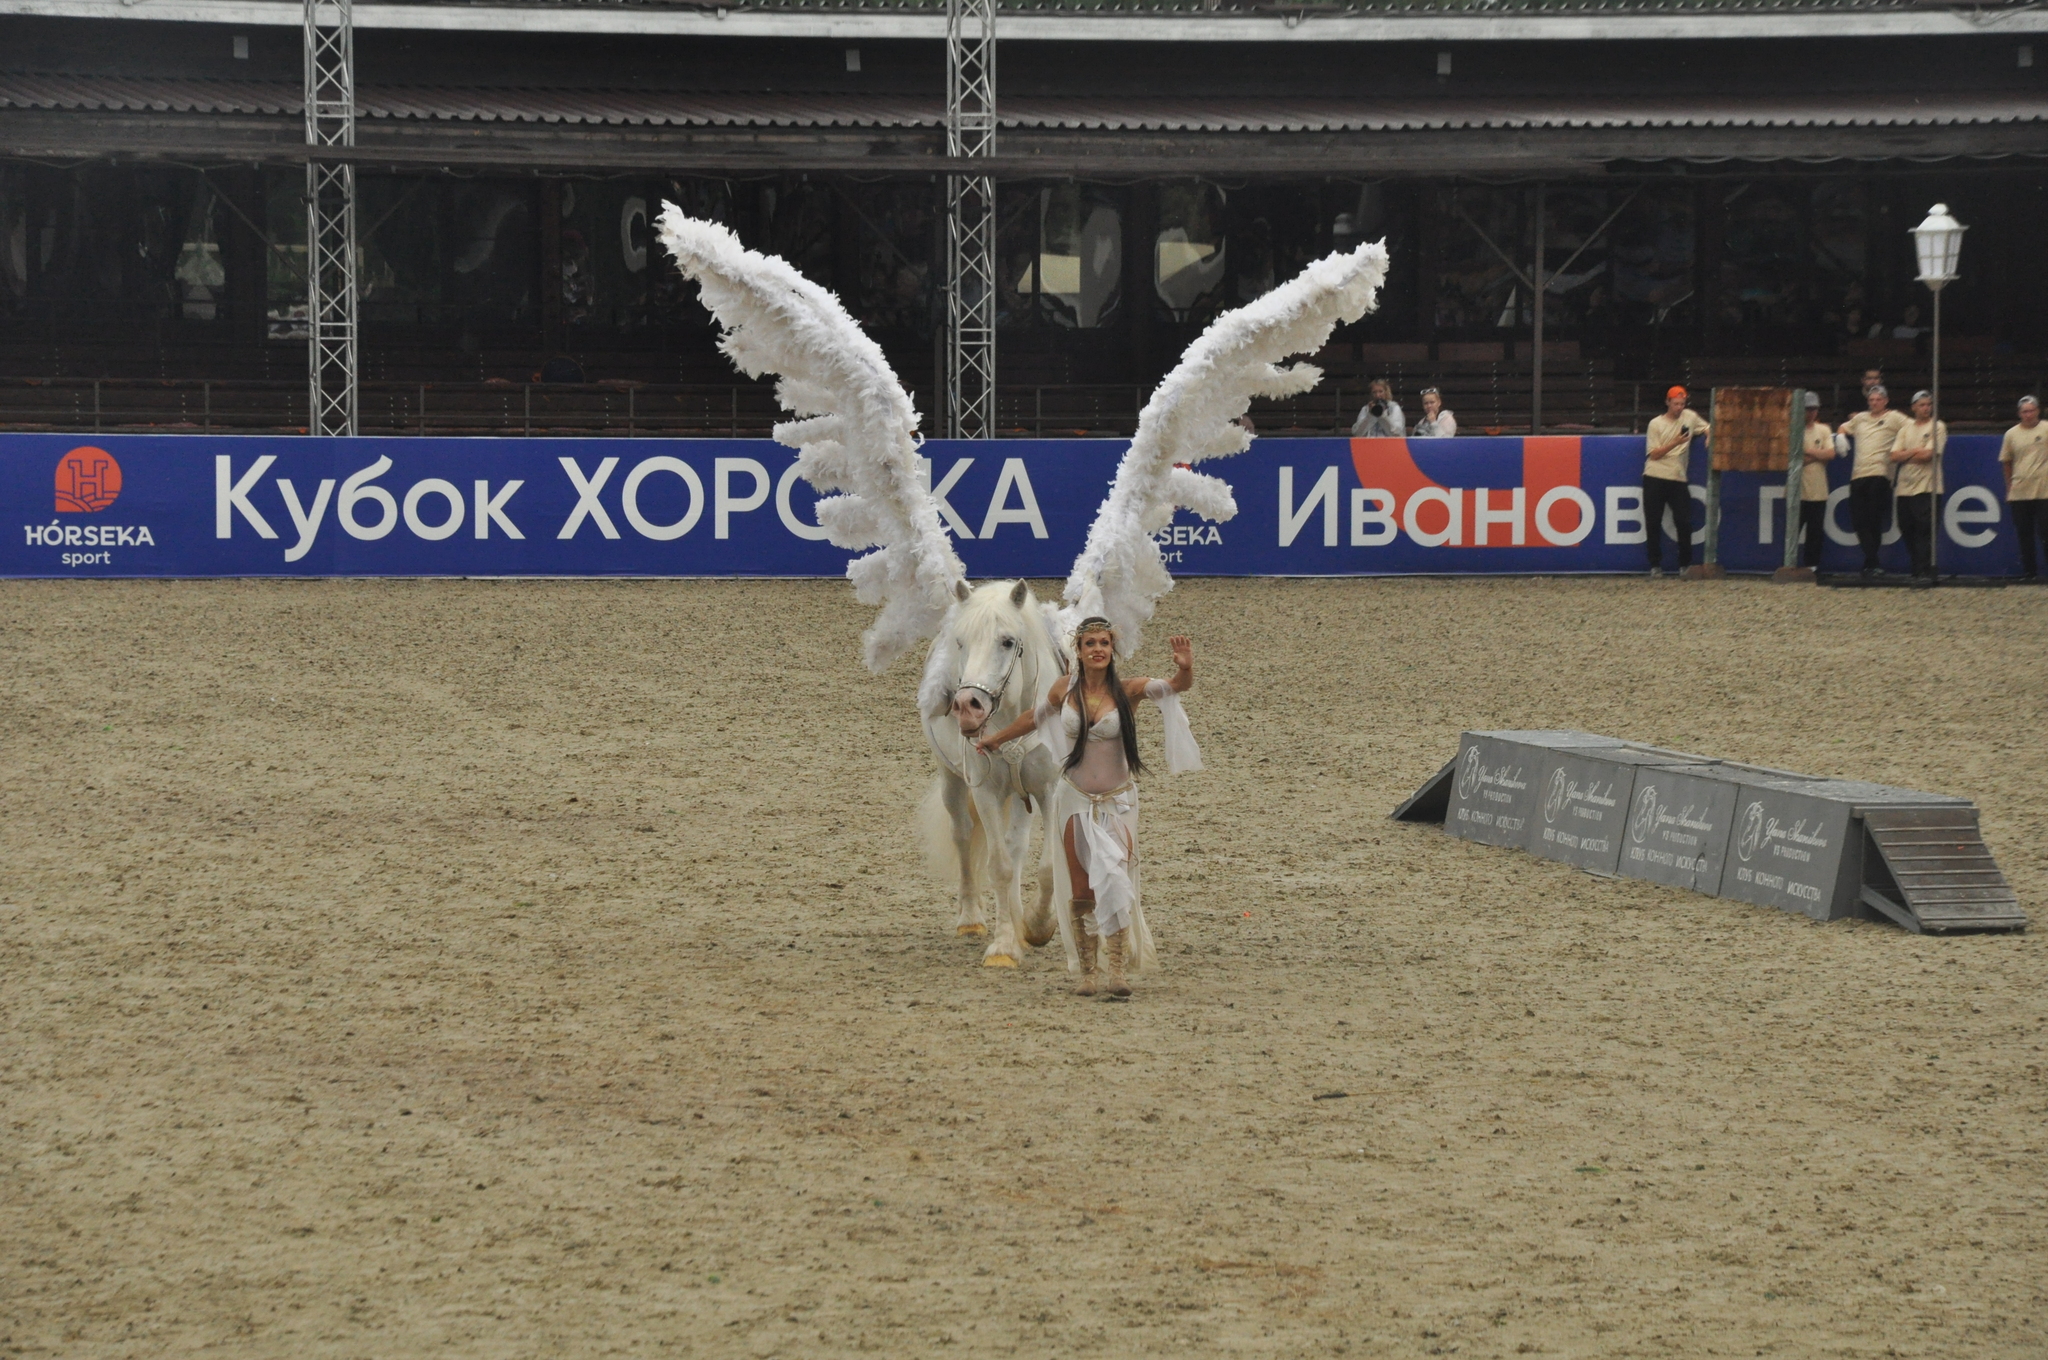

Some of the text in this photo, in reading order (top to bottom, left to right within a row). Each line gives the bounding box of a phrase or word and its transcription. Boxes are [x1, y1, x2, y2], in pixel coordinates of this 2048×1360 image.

[215, 454, 1050, 563] Кубок ХОРСКА
[1758, 484, 2002, 549] пое
[24, 518, 156, 547] HÓRSEKA
[61, 550, 111, 568] sport
[1159, 550, 1183, 563] ort
[1760, 817, 1787, 850] Yana
[1737, 867, 1754, 882] КЛУБ
[1754, 871, 1784, 890] КОННОГО
